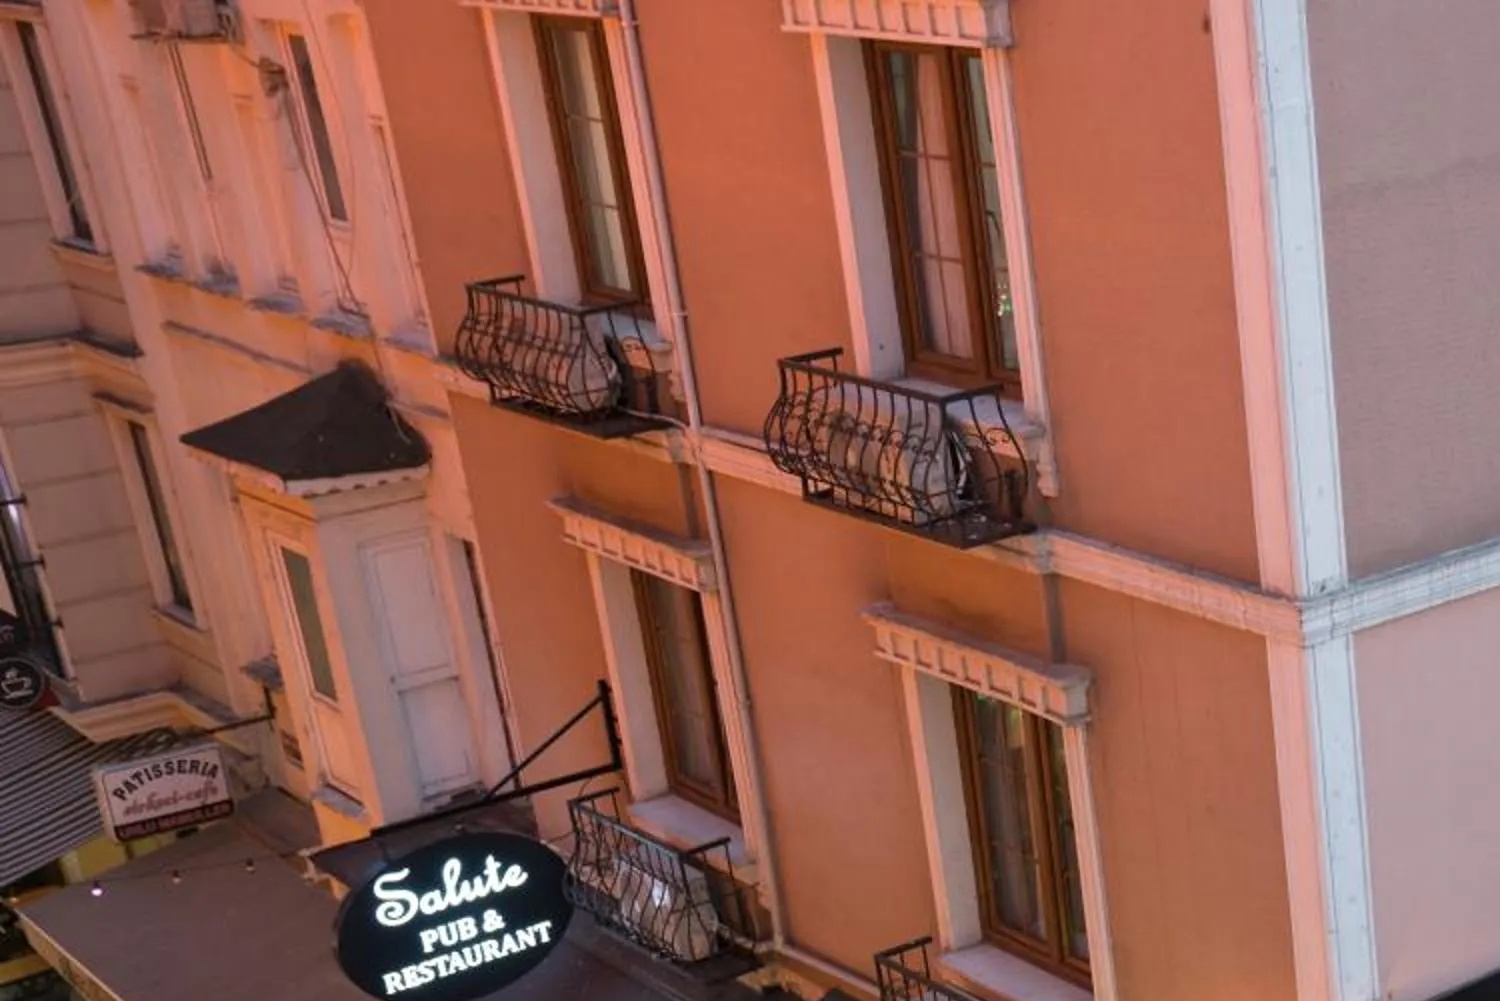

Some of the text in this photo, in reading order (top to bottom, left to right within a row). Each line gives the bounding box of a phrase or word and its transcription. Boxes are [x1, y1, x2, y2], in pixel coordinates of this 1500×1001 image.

[112, 759, 220, 801] PATISSERIA
[373, 854, 529, 928] Salute
[381, 919, 552, 996] RESTAURANT
[419, 908, 505, 954] PUB &
